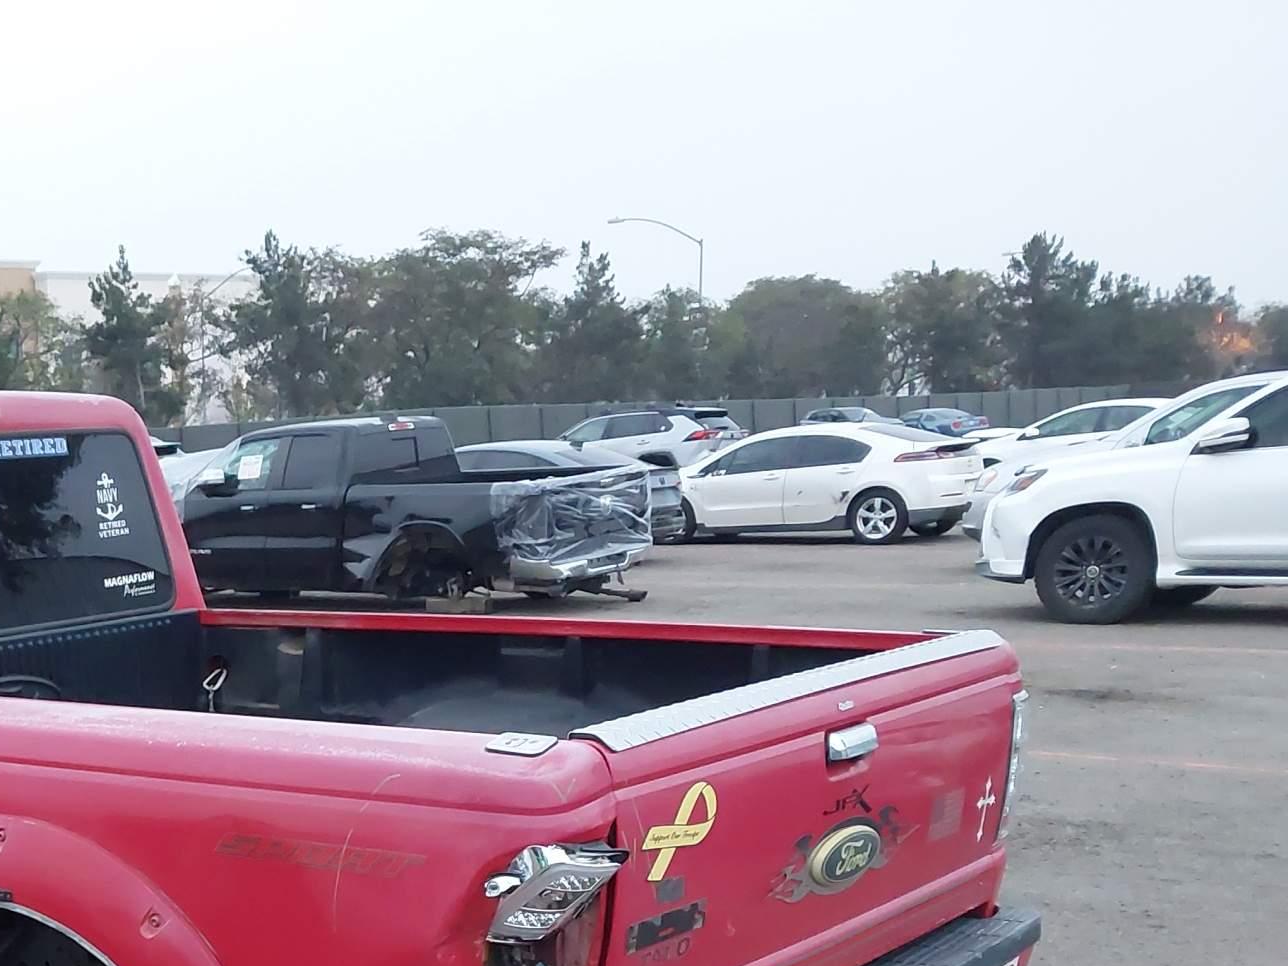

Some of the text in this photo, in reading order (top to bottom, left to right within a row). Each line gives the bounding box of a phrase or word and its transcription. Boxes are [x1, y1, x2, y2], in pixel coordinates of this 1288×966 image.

[96, 487, 118, 504] NAVY
[99, 519, 126, 530] RETIRED
[99, 527, 130, 538] VETERAN
[104, 570, 155, 588] MAGNAFLOW
[835, 839, 873, 876] Ford
